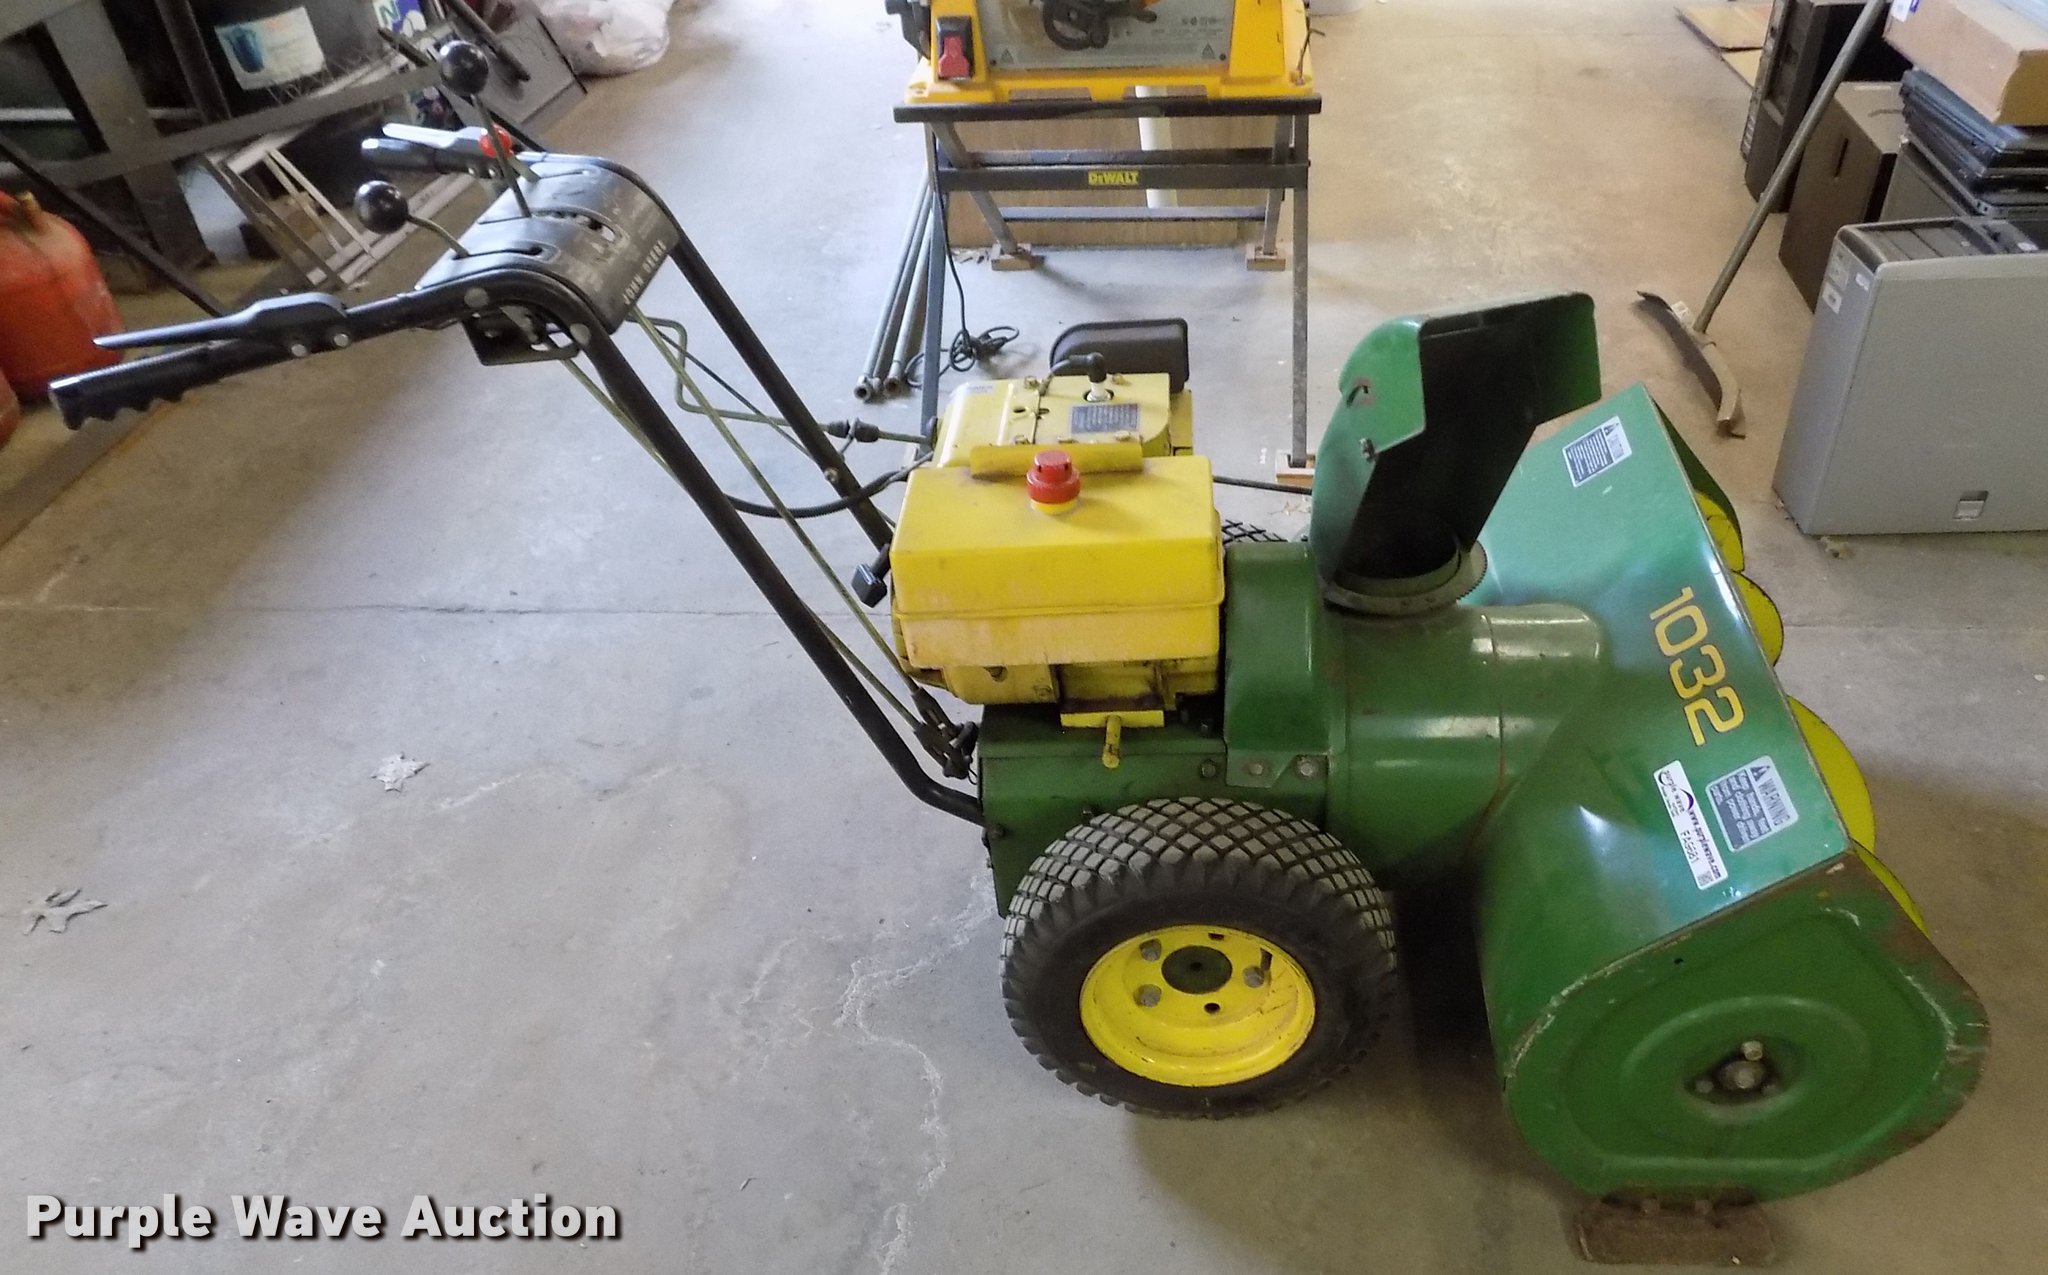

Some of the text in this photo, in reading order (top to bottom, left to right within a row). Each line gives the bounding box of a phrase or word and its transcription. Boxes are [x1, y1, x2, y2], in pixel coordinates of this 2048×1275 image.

[622, 273, 644, 305] JOHN
[642, 239, 667, 273] DEERE
[1649, 586, 1745, 746] 1032
[1756, 778, 1791, 827] WARNING
